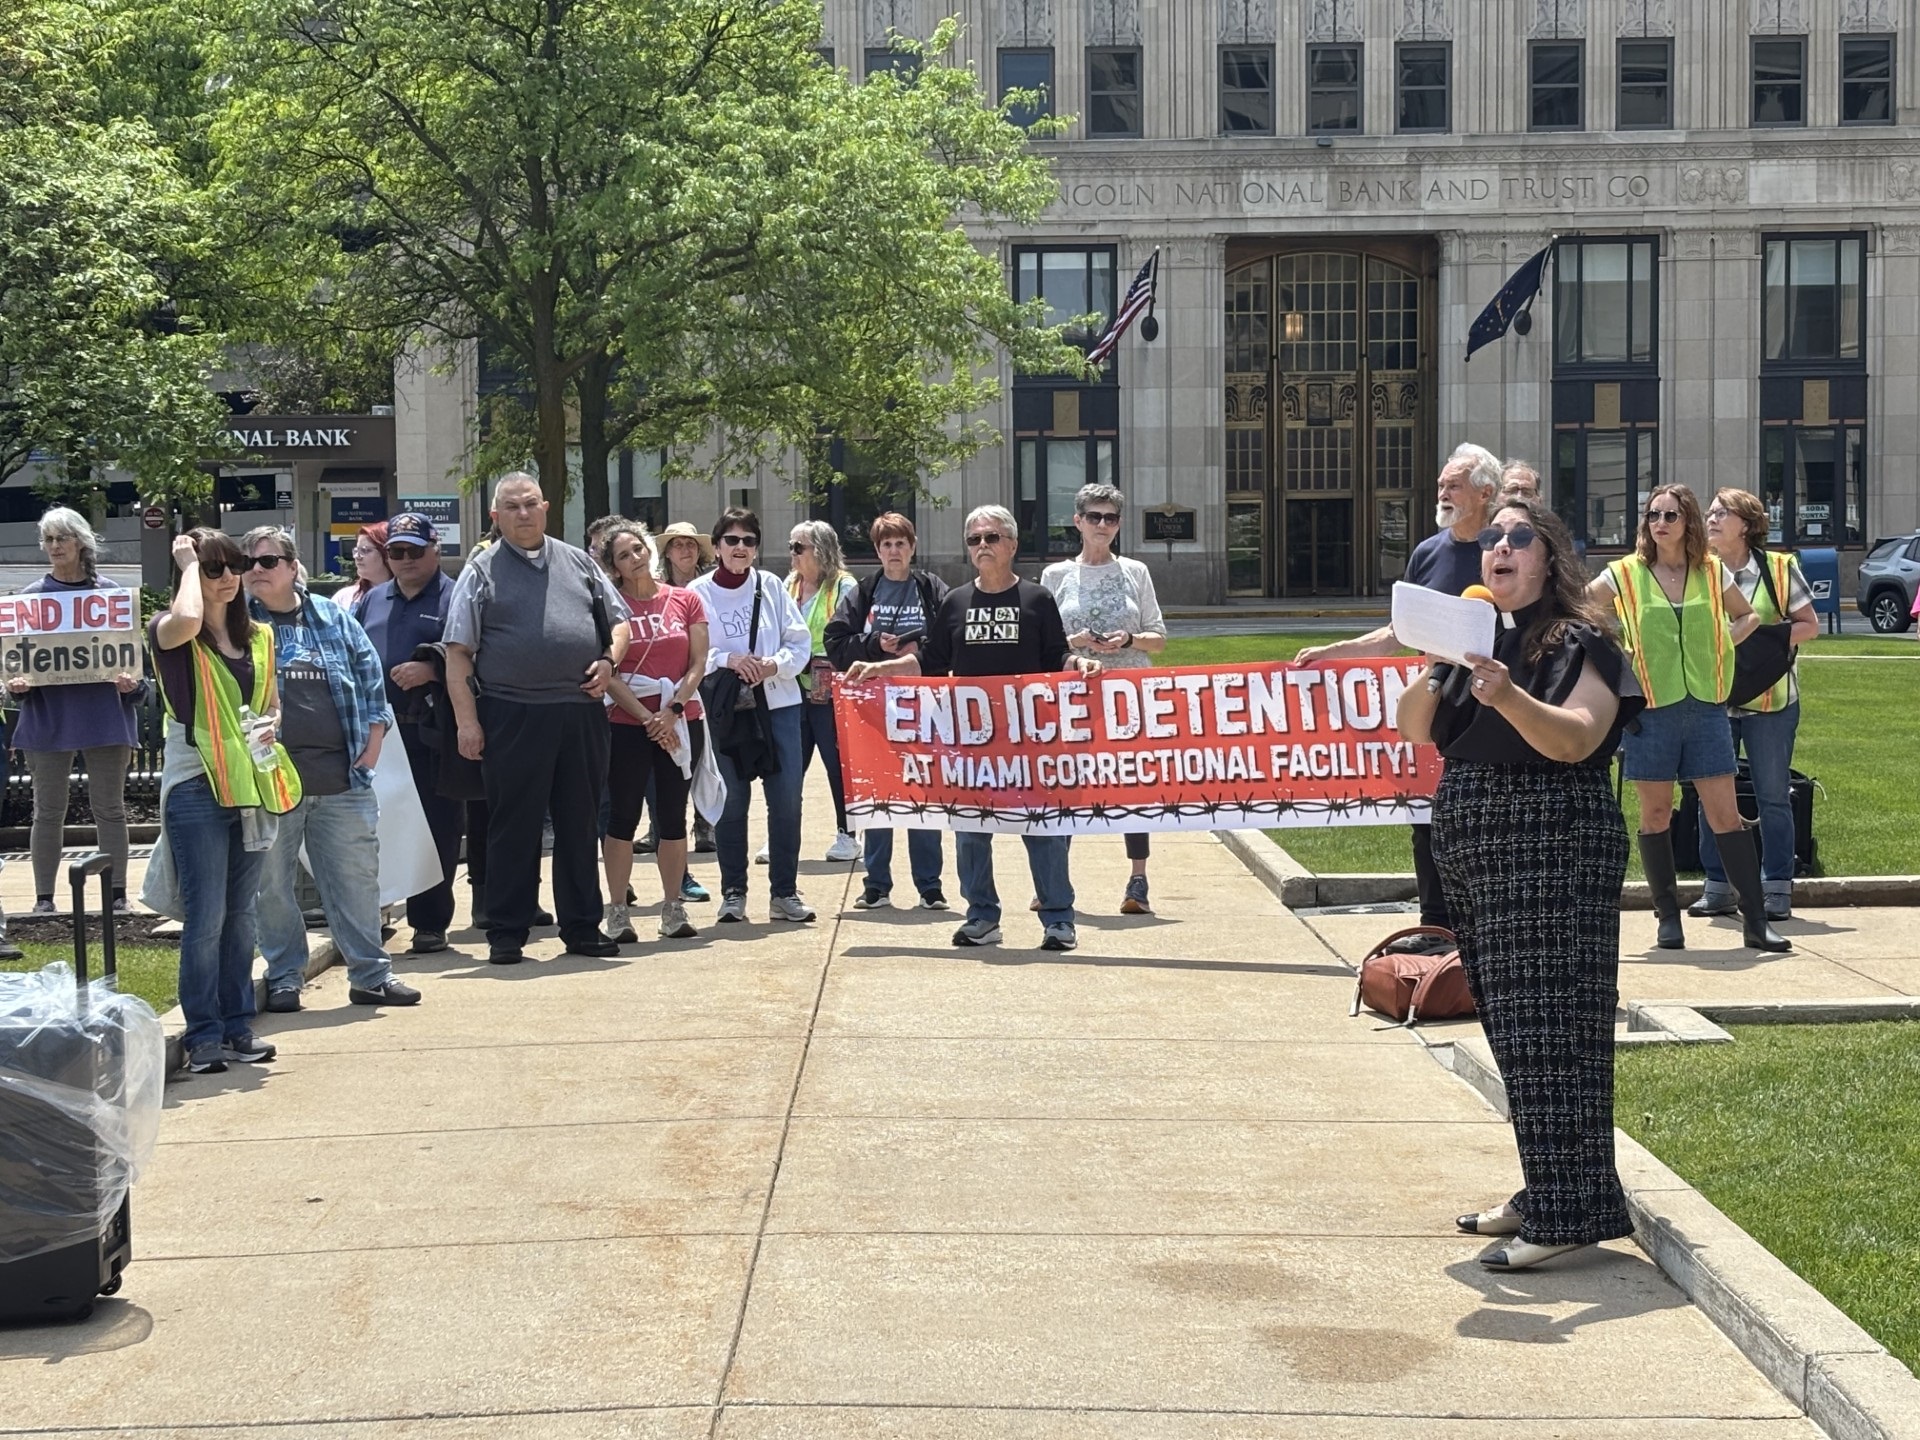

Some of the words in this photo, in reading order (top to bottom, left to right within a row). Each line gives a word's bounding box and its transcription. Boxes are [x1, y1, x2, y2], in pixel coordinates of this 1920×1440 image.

[1057, 183, 1155, 206] NCOLN
[1176, 181, 1323, 206] NATIONAL
[1338, 179, 1415, 203] BANK
[1426, 178, 1490, 202] AND
[1501, 176, 1594, 200] TRUST
[1607, 175, 1650, 198] CO
[285, 429, 351, 446] BANK
[0, 598, 62, 633] END
[73, 595, 130, 630] ICE
[0, 636, 135, 674] etension
[285, 671, 326, 680] FOOTBAL
[885, 685, 994, 746] END
[1003, 680, 1092, 744] ICE
[1101, 665, 1419, 741] DETENTION
[903, 753, 934, 786] AT
[941, 754, 1032, 789] MIAMI
[1037, 745, 1266, 787] CORRECTIONAL
[1270, 741, 1416, 778] FACILITY!
